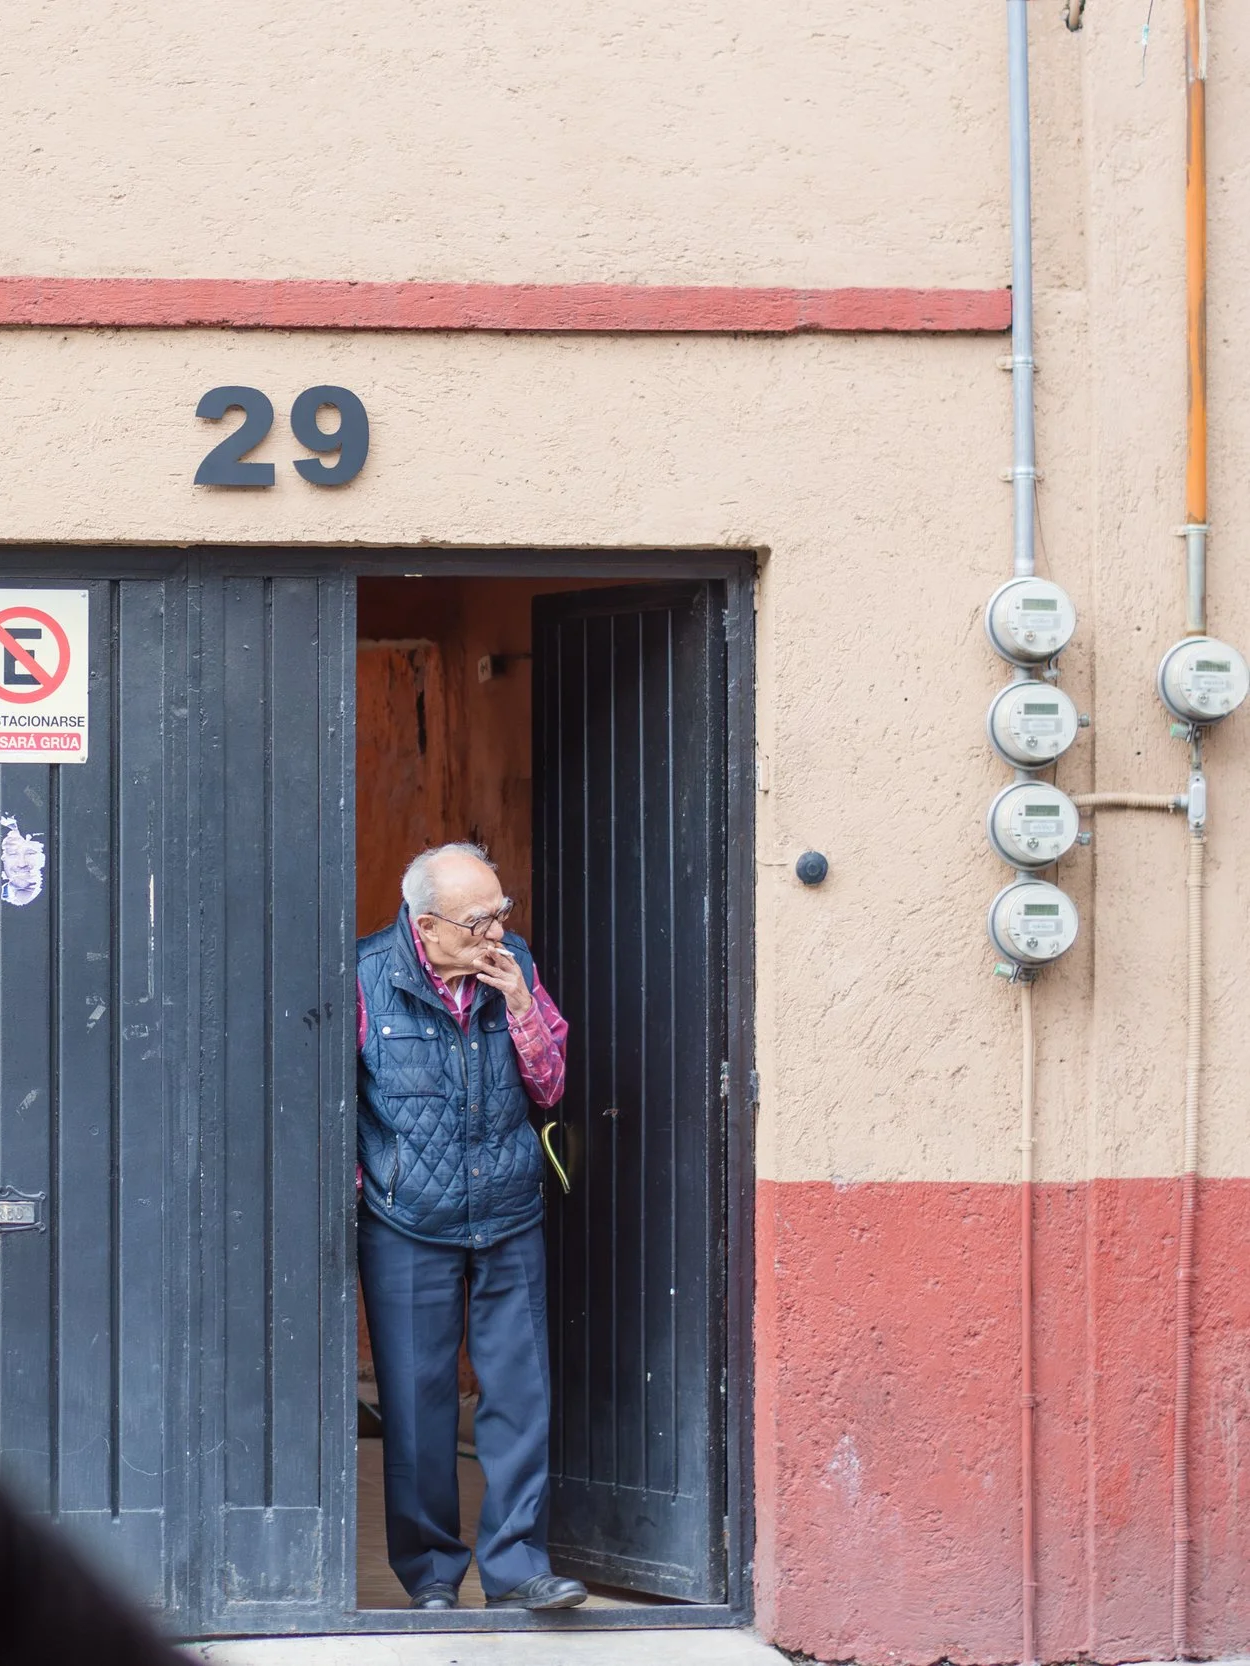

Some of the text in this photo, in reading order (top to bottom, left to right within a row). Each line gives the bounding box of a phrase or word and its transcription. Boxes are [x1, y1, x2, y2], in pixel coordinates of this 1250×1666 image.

[194, 385, 370, 486] 29
[3, 628, 43, 685] E
[40, 734, 80, 749] GRÚA
